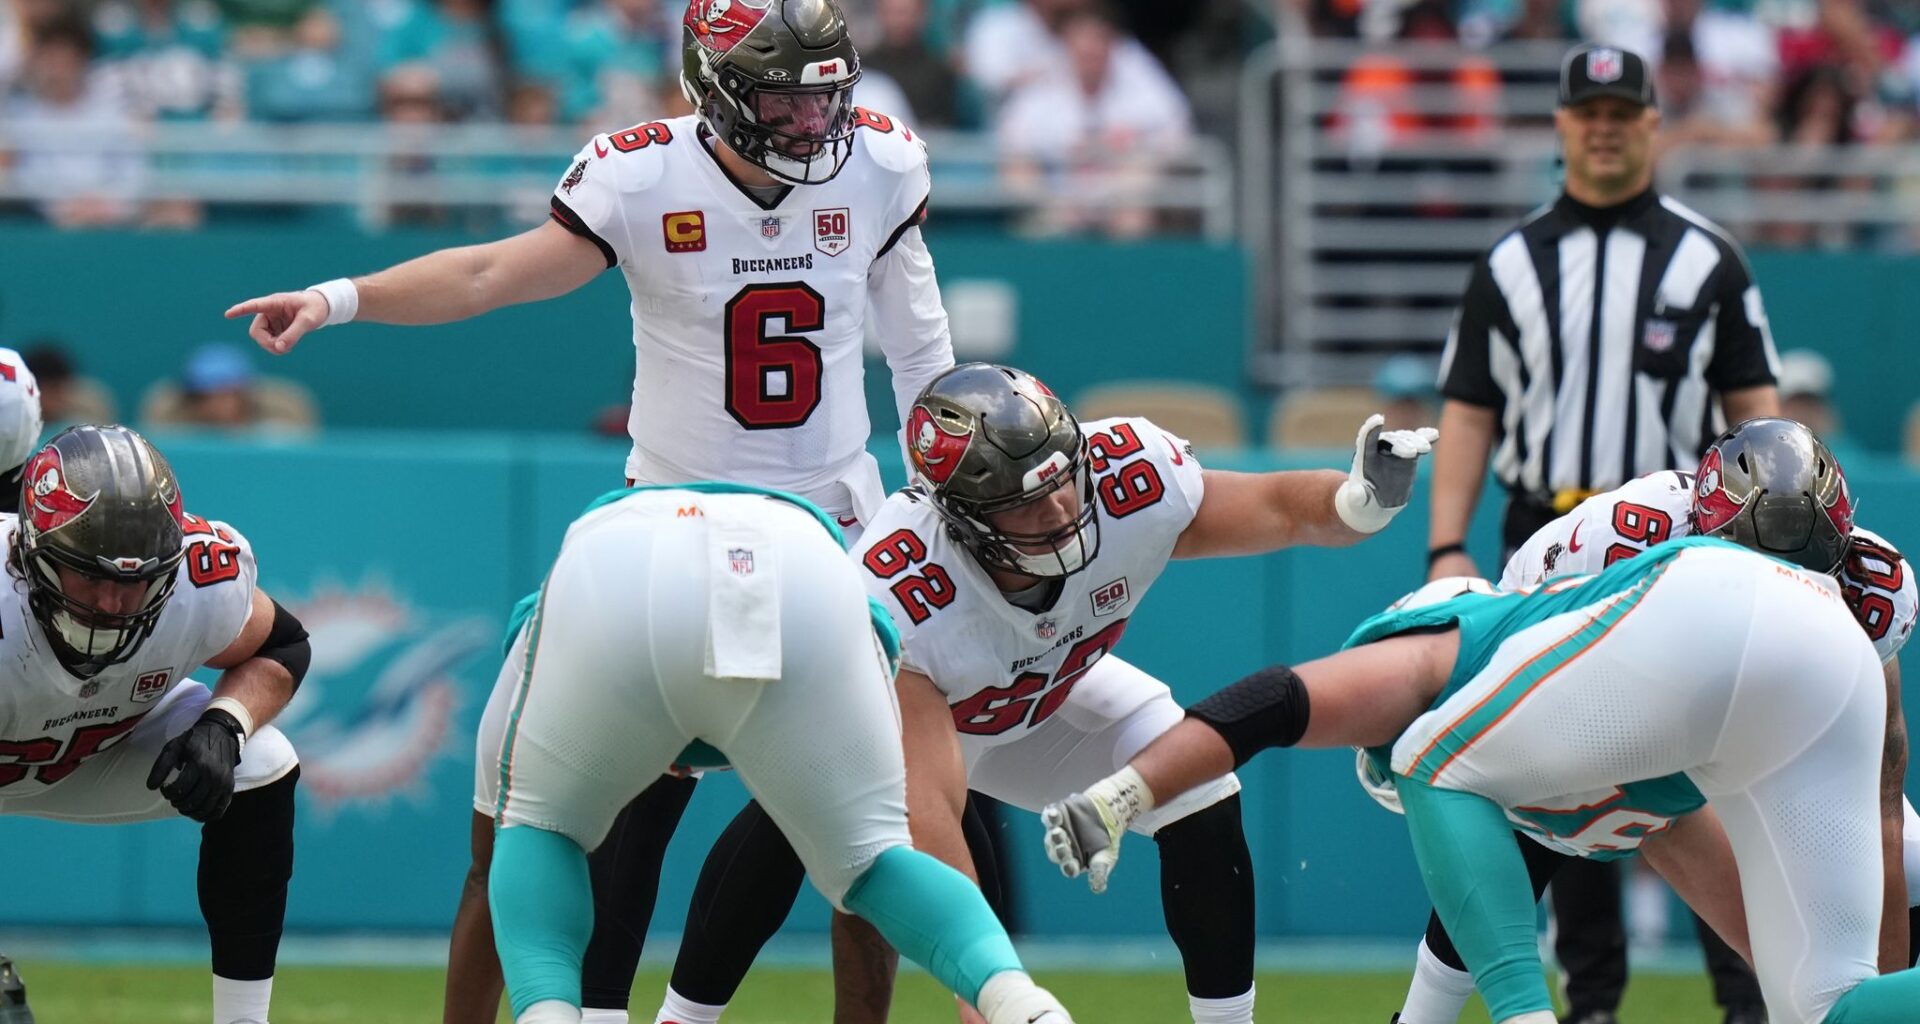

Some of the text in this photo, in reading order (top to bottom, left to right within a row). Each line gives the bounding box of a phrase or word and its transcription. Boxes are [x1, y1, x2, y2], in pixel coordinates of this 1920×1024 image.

[608, 122, 674, 154] 6
[666, 214, 702, 243] C
[817, 213, 846, 236] 50
[724, 280, 826, 431] 6
[1088, 422, 1166, 520] 62
[862, 528, 957, 627] 62
[1094, 582, 1125, 608] 50
[136, 673, 168, 692] 50
